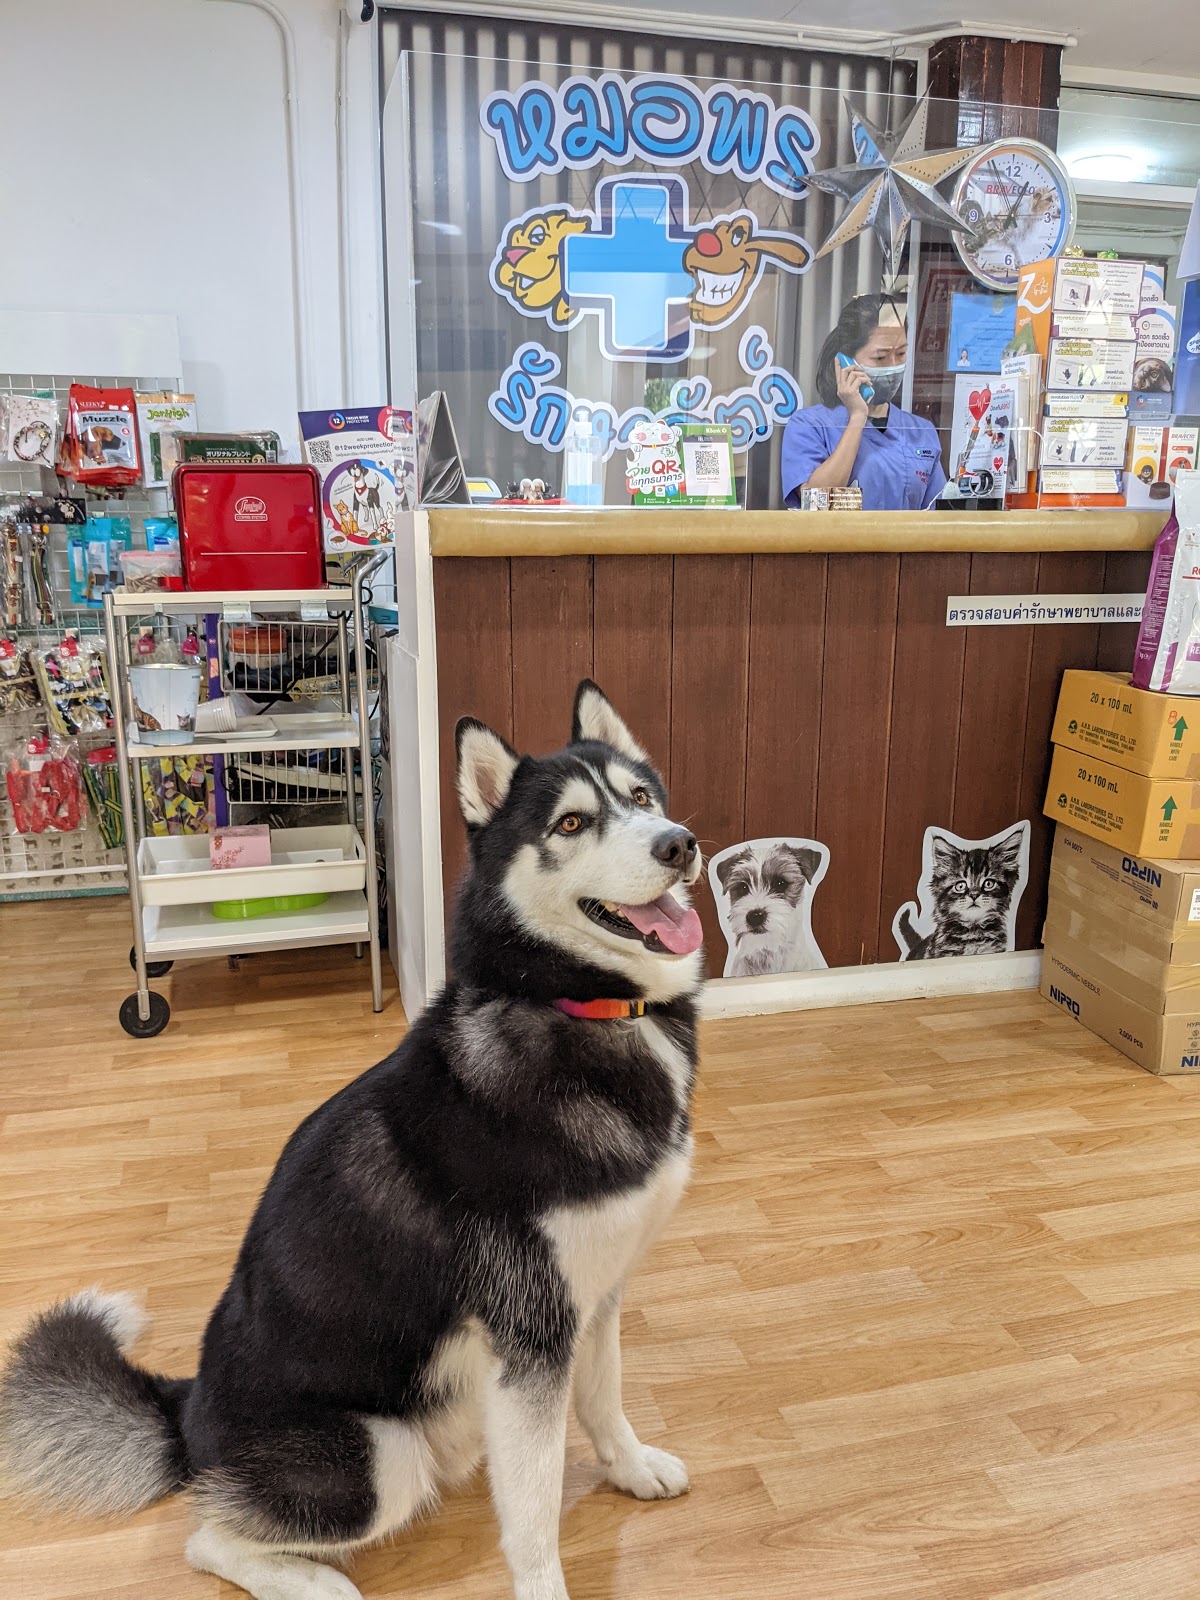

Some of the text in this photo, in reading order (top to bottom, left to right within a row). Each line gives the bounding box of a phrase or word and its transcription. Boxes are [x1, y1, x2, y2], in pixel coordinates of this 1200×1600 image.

[486, 77, 815, 194] หมอพร
[1006, 166, 1021, 178] 12
[986, 184, 1035, 195] BRVECO
[969, 210, 978, 222] 9
[1044, 212, 1051, 224] 3
[1005, 255, 1012, 265] 6
[82, 416, 127, 424] Muzzle
[147, 408, 190, 420] JerHigh
[627, 460, 679, 477] จ่าย QR
[949, 602, 1144, 621] ตรวจสอบค่ารักษาพยาบาลและ
[1190, 646, 1200, 654] RE
[1090, 692, 1133, 714] 20 x 100 mL
[1078, 768, 1119, 794] 20 x 100 mL
[1122, 857, 1162, 889] NIPRO
[1051, 956, 1101, 996] HYPODERMIC NEEDLE
[1050, 984, 1080, 1017] NIPRO
[1118, 1028, 1144, 1049] 2,000 PCS
[1181, 1056, 1200, 1067] NI
